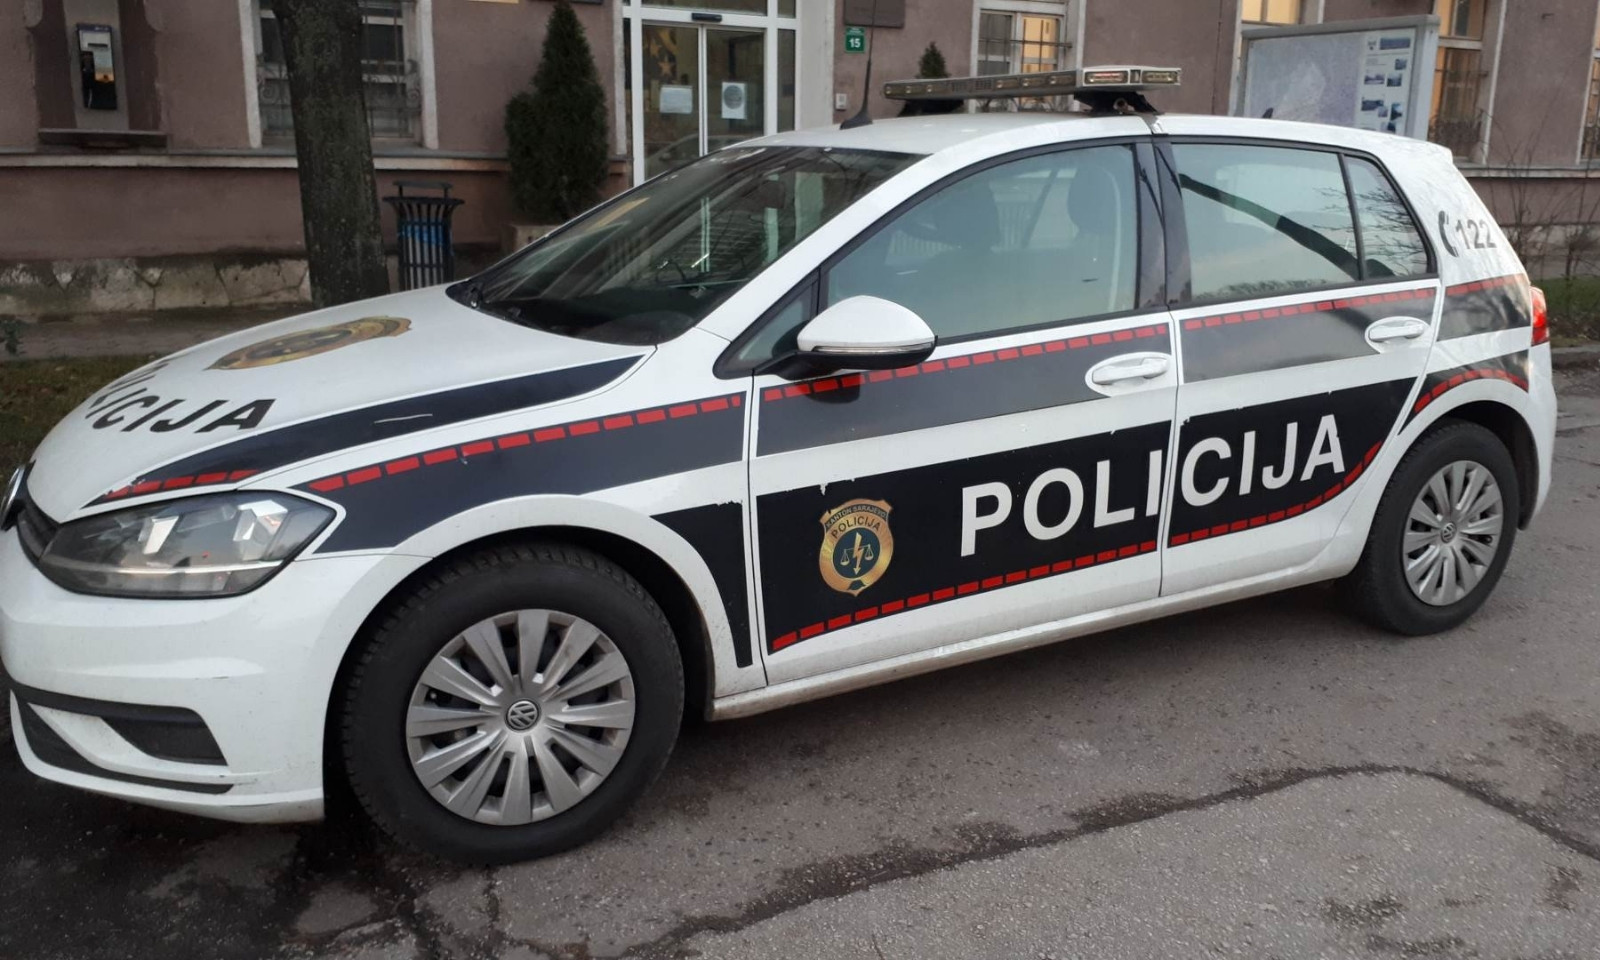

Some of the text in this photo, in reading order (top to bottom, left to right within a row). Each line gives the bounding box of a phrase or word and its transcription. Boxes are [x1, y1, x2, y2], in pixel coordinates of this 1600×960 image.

[848, 38, 861, 48] 15
[1456, 219, 1497, 249] 122
[960, 414, 1345, 557] POLICIJA
[826, 508, 852, 528] KANTON
[831, 516, 881, 539] POLICIJA
